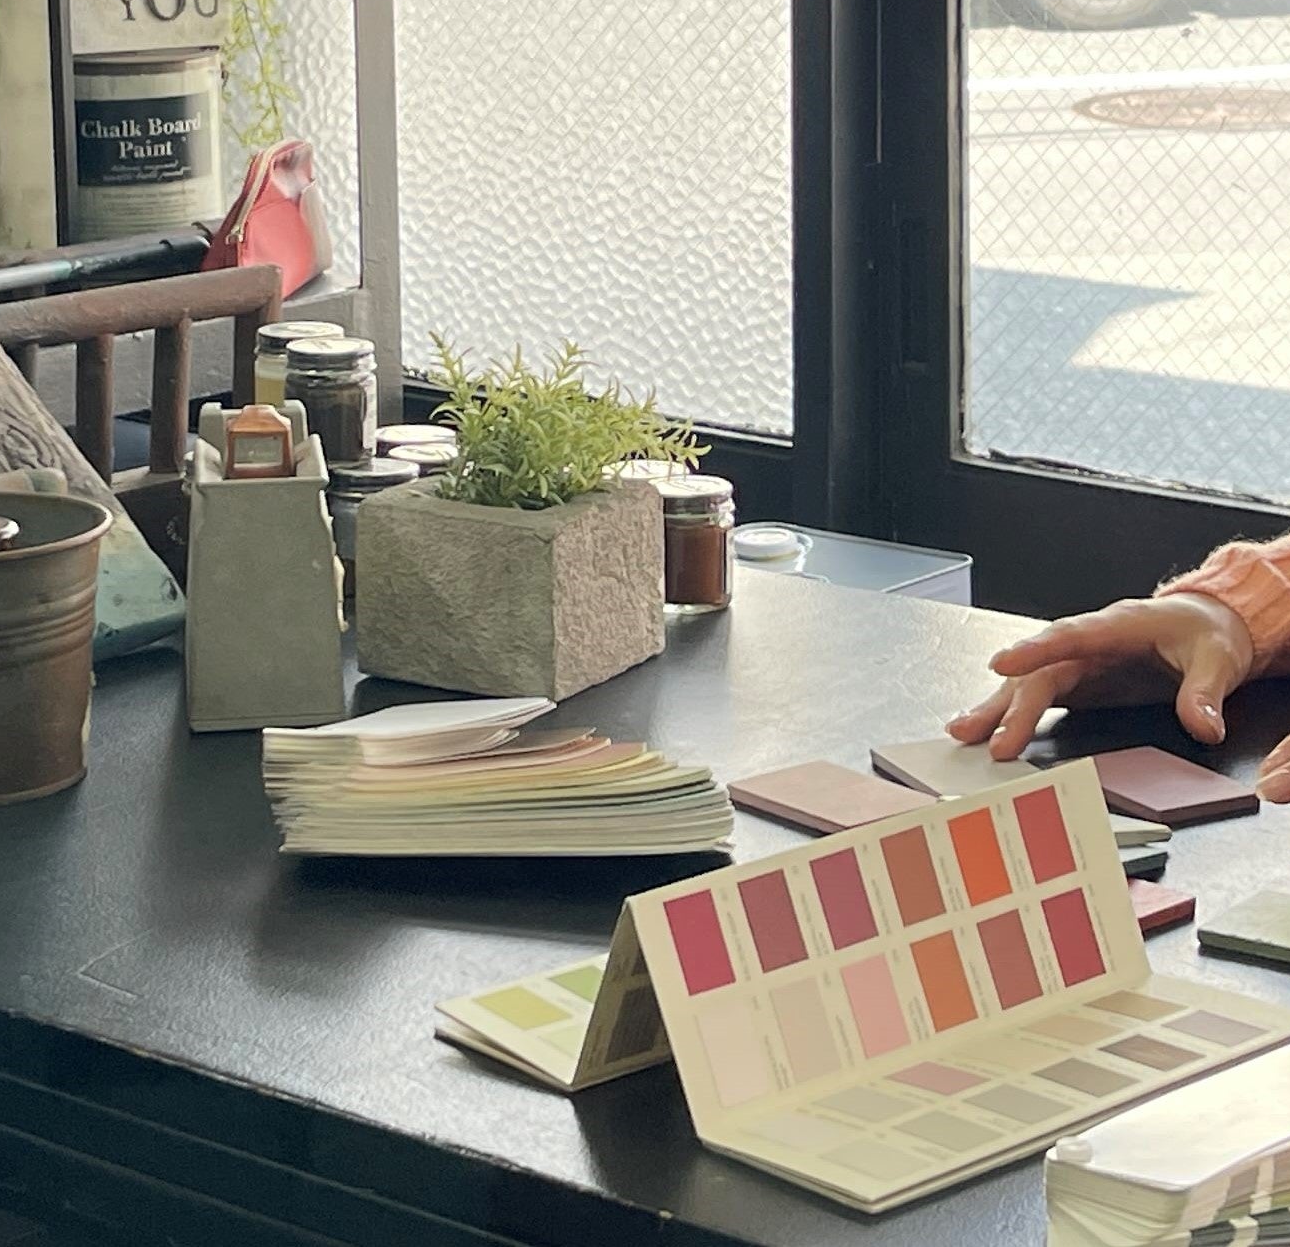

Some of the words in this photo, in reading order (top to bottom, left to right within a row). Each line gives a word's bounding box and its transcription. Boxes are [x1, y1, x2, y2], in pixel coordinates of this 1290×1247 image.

[81, 118, 142, 139] Chalk
[148, 112, 202, 136] Board
[118, 140, 173, 159] Paint
